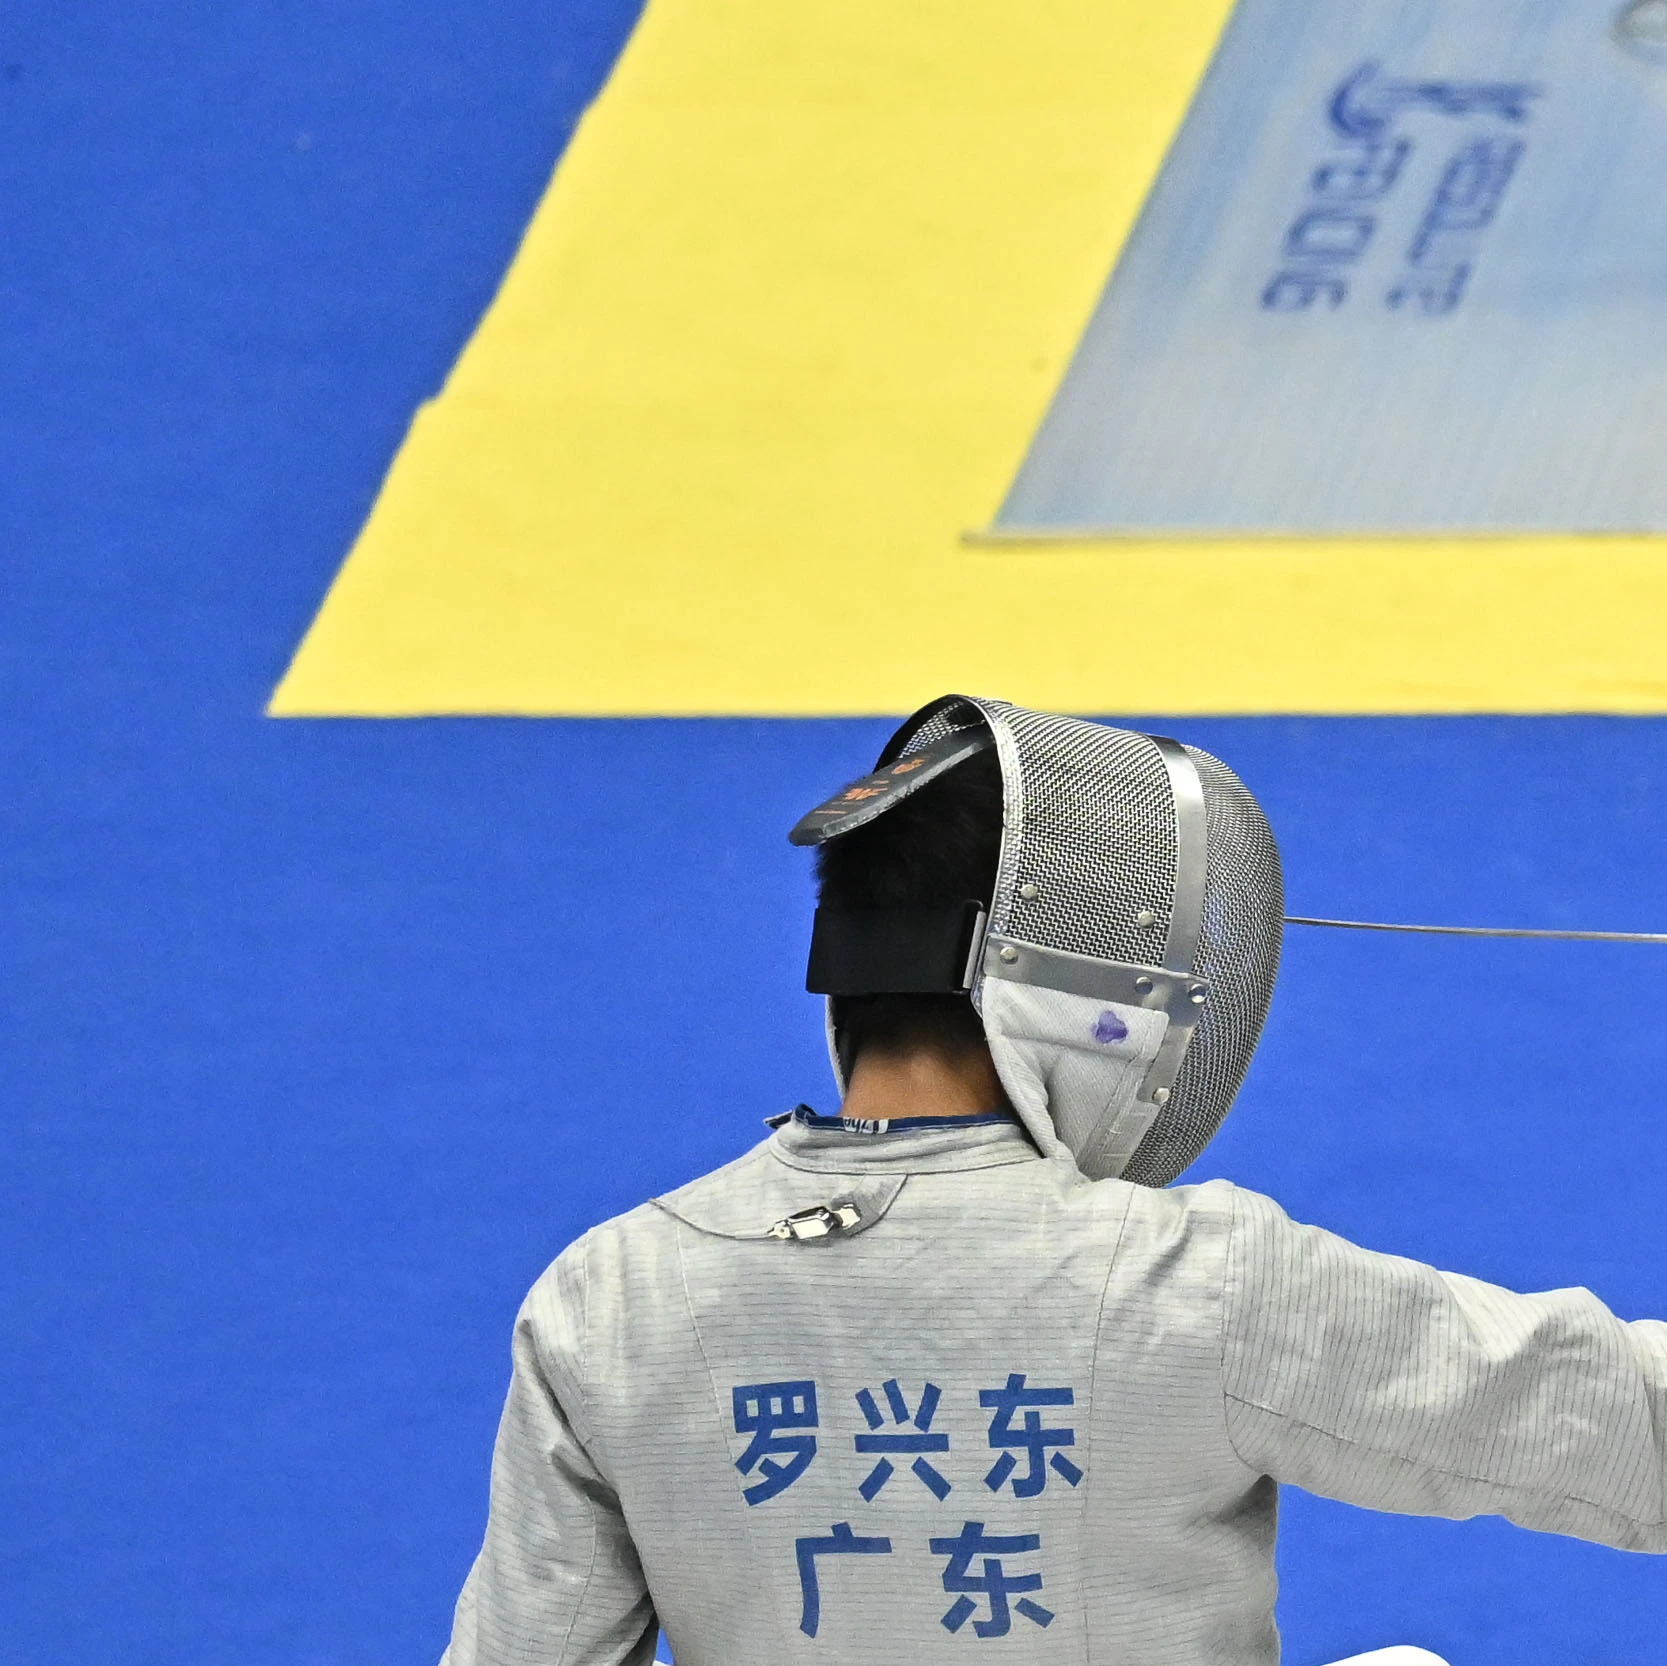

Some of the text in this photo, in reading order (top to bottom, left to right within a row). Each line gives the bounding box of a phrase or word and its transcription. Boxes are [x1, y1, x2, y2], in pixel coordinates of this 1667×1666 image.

[733, 1373, 1084, 1506] 罗兴东
[795, 1521, 1056, 1639] 广东
